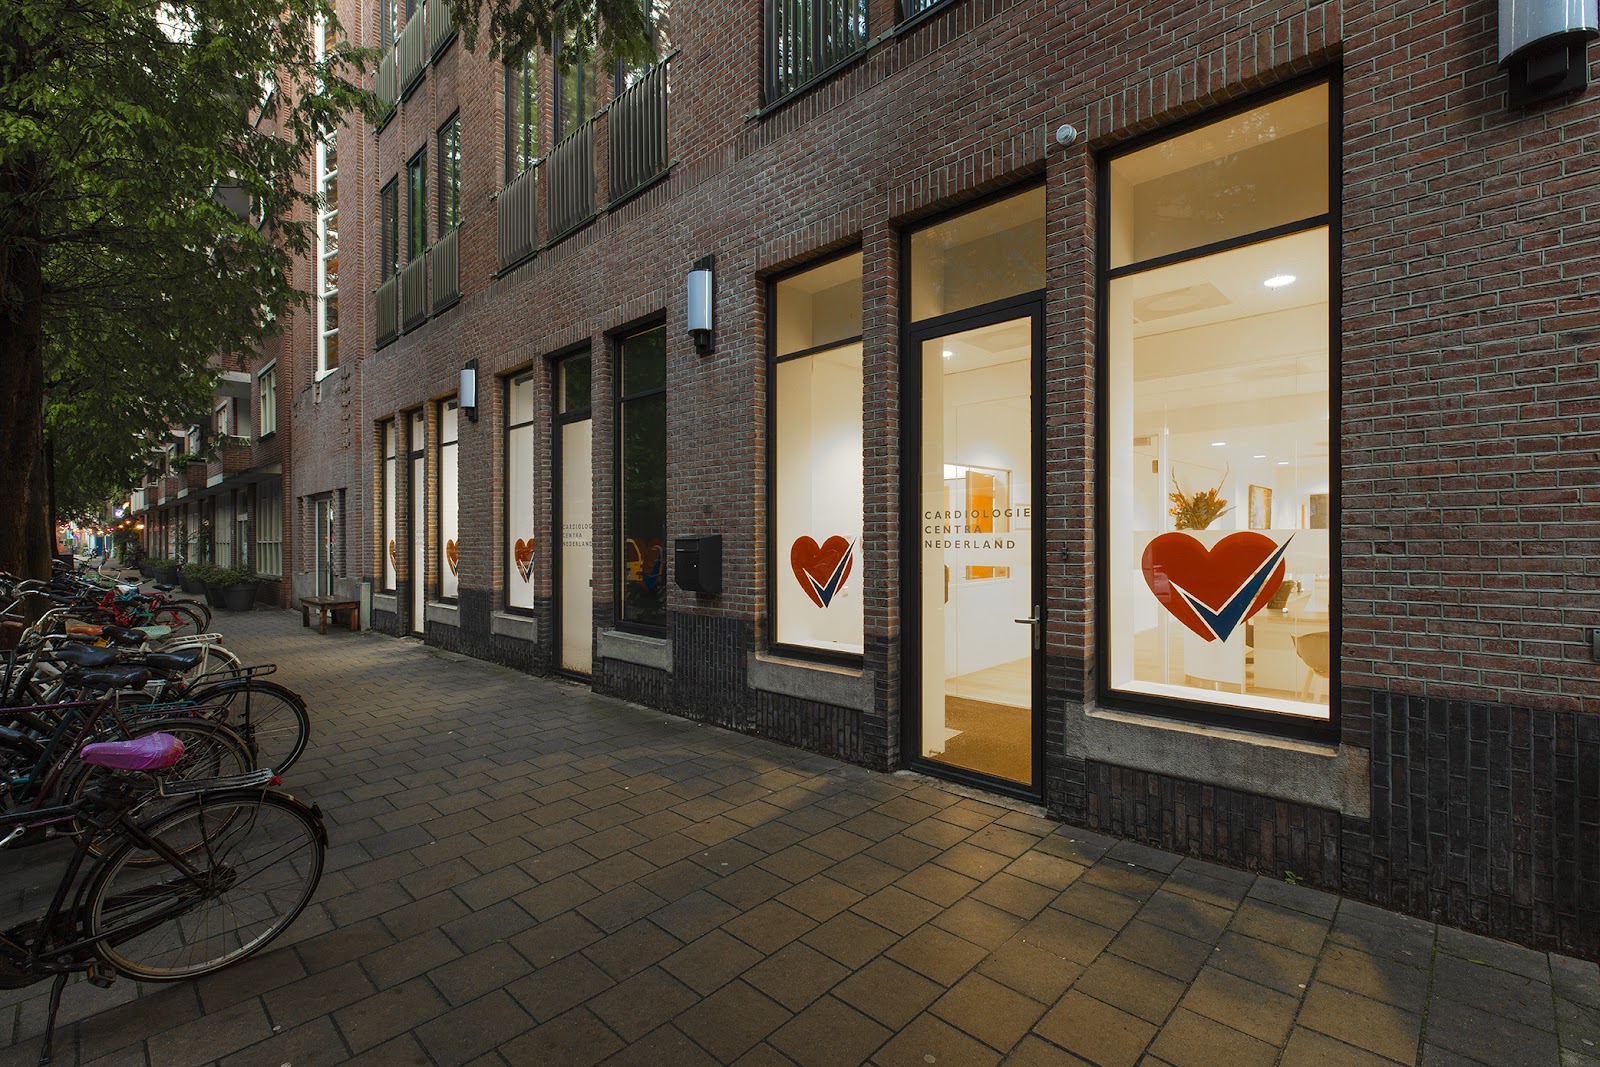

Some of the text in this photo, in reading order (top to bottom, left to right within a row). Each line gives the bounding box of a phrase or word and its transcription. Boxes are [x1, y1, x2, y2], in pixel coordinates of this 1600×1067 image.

[925, 508, 1030, 519] CARDIOLOGIE
[925, 525, 982, 534] CENTRA
[925, 540, 1015, 549] NEDERLAND
